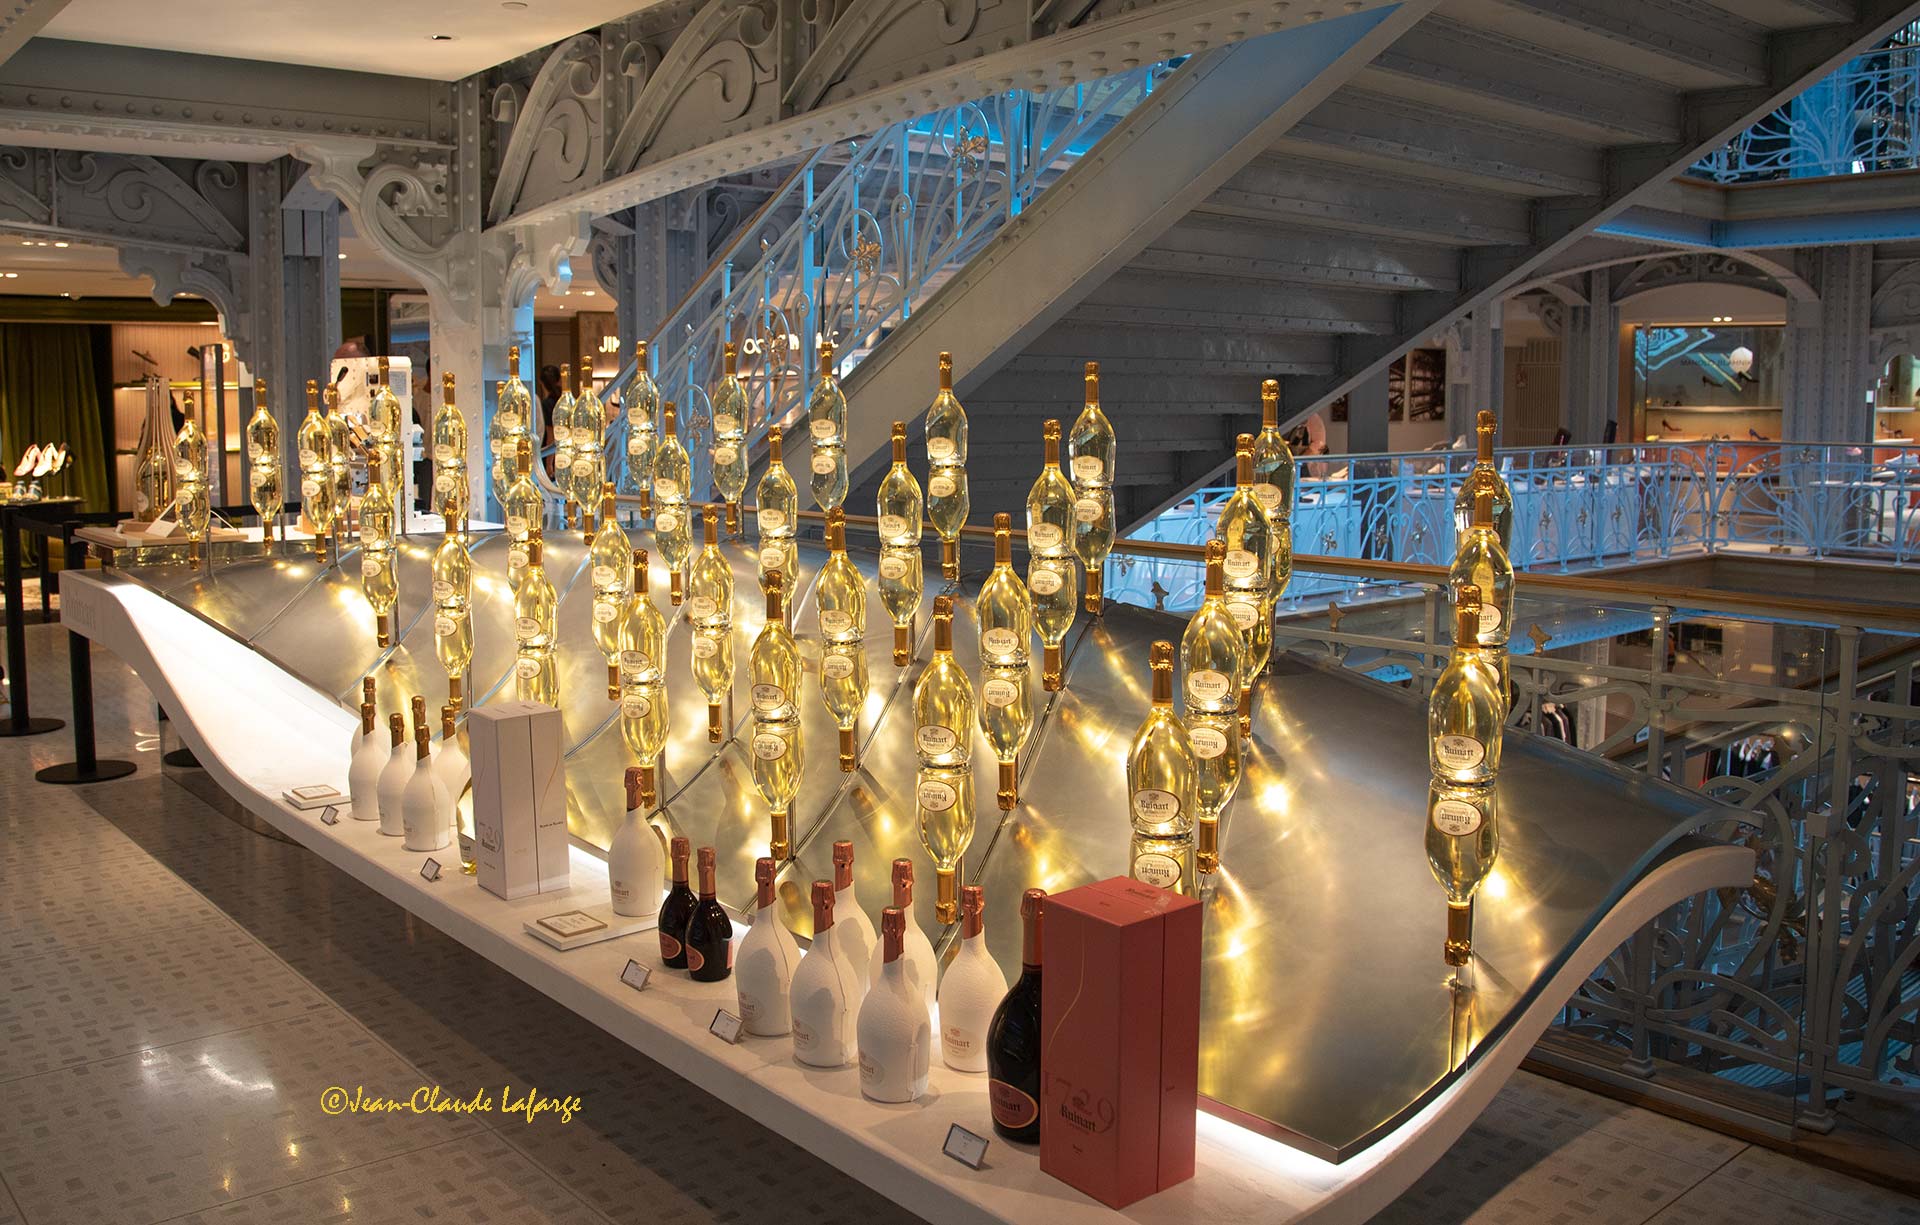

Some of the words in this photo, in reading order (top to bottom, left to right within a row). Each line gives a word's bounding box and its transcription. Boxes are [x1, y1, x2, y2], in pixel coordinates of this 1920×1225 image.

[1227, 558, 1250, 567] Ruinart
[1194, 680, 1221, 689] Ruinart
[922, 733, 948, 744] Ruinart
[1444, 745, 1474, 756] Ruinart
[1140, 799, 1169, 810] Ruinart
[1060, 1104, 1097, 1132] Ruinart
